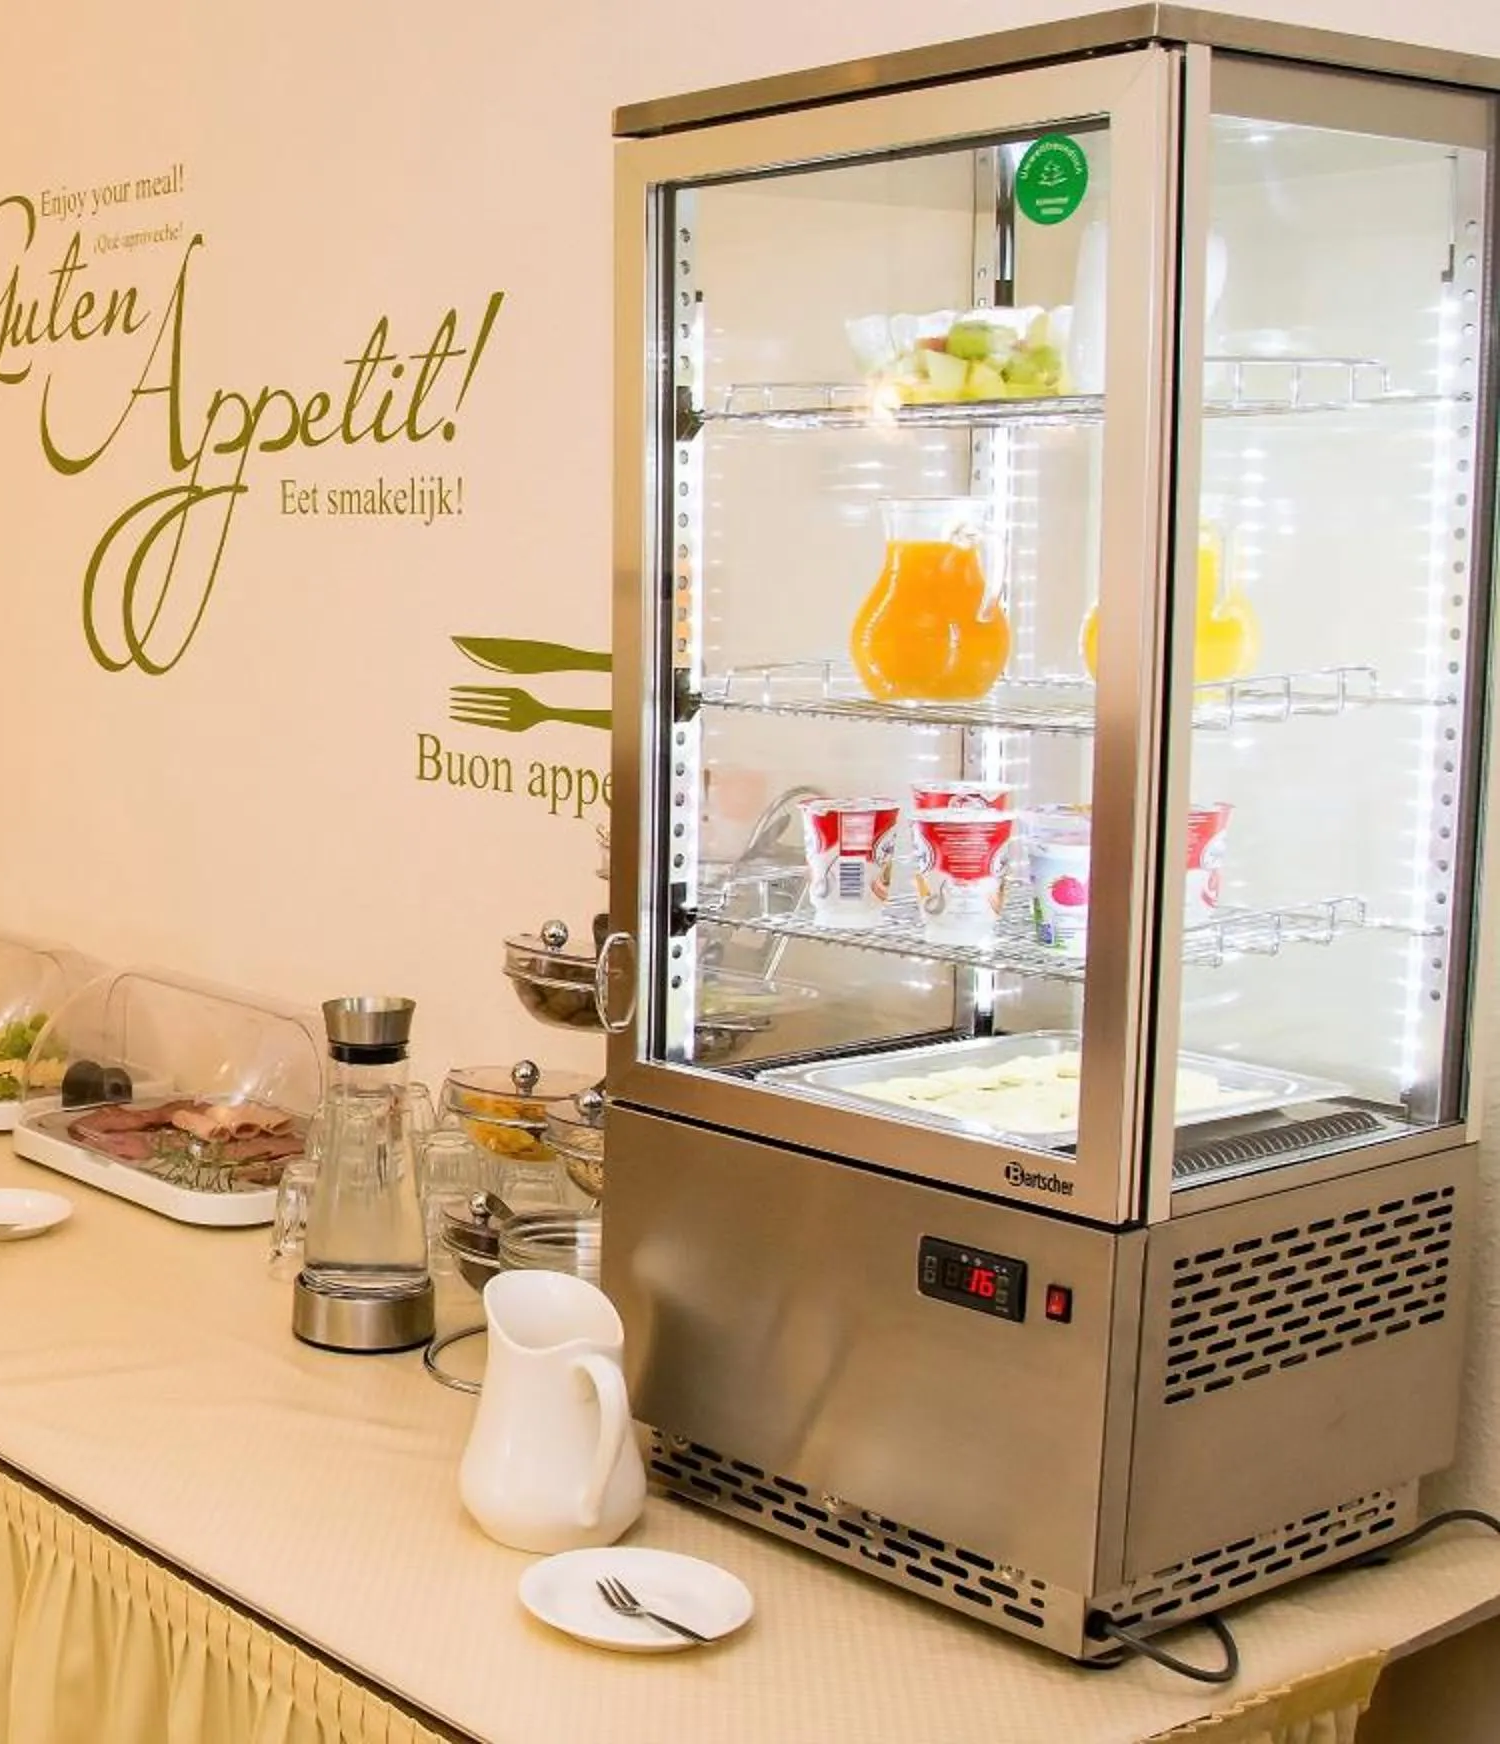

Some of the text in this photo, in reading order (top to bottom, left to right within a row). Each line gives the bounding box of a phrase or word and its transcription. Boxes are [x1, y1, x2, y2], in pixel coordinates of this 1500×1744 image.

[41, 163, 184, 221] Enjoy your meal!
[40, 233, 505, 676] Appetit!
[280, 476, 463, 526] Eet smakelijk!
[415, 732, 513, 792] Buon
[1004, 1160, 1074, 1196] Bartscher
[968, 1267, 997, 1298] 16
